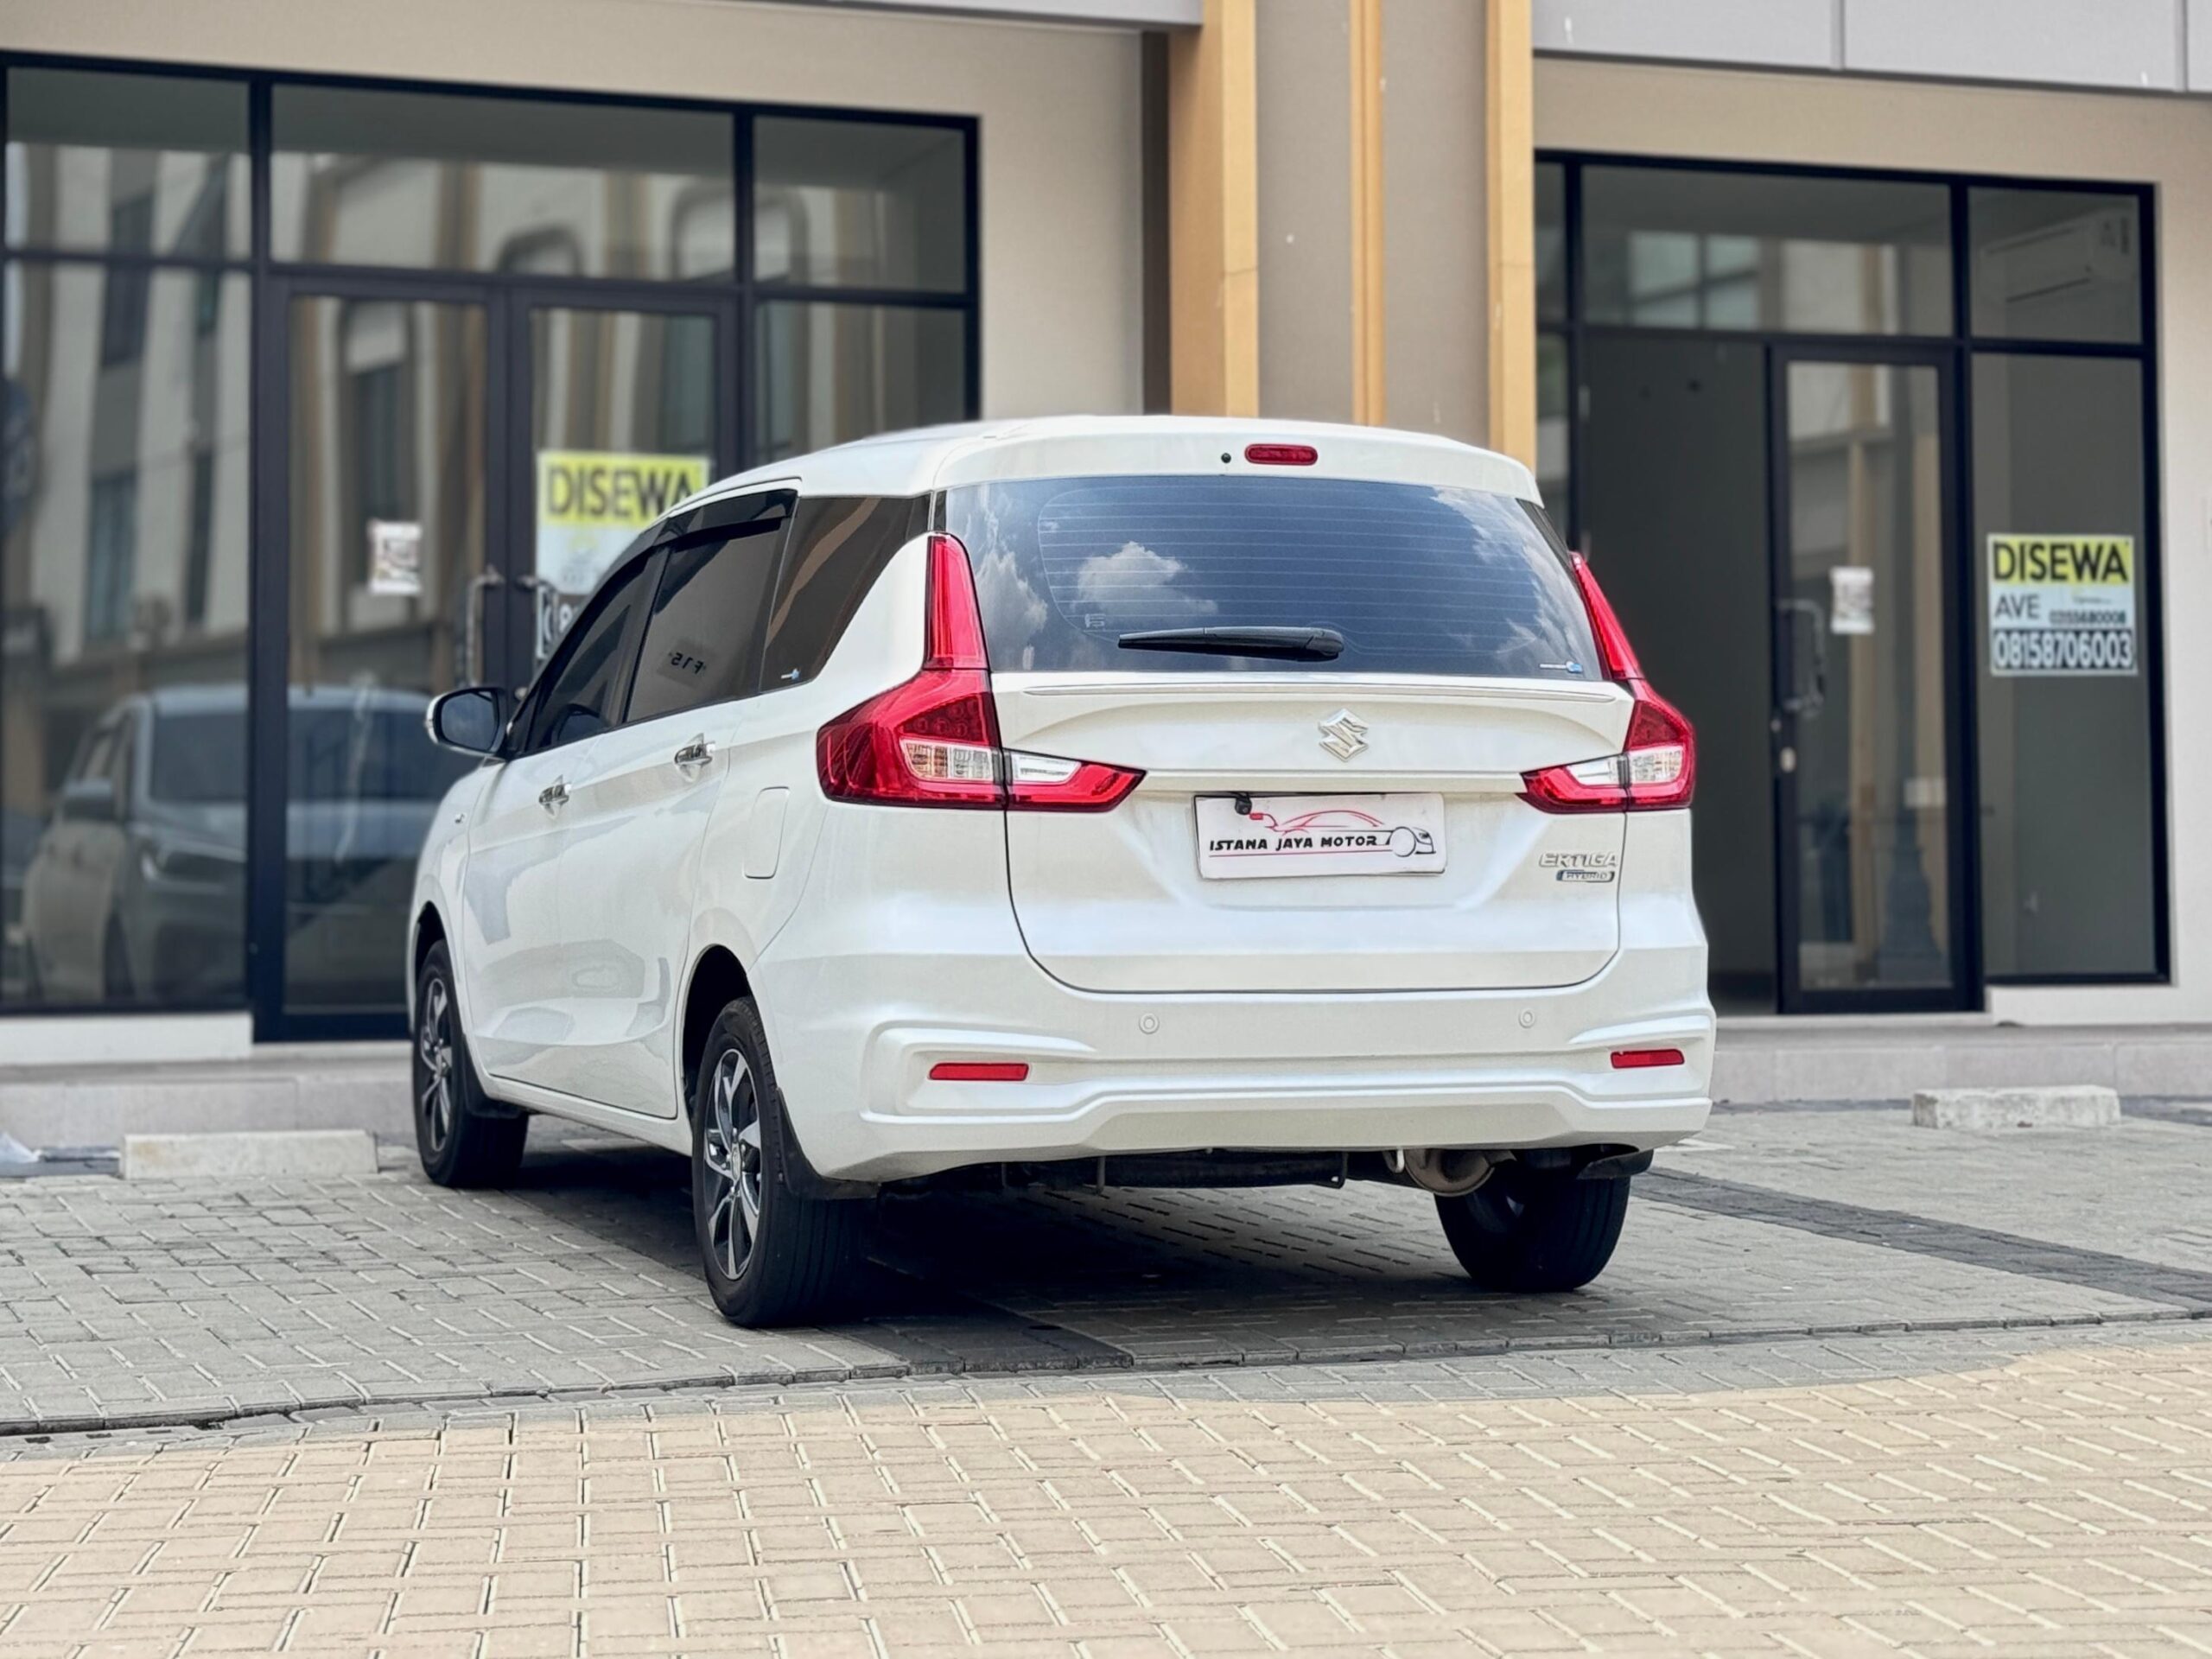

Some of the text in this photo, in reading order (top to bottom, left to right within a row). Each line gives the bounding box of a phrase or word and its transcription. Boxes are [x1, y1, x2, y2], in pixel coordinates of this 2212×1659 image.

[549, 464, 695, 518] DISEWA
[1993, 542, 2129, 582] DISEWA
[1994, 594, 2040, 620] AVE
[1994, 631, 2133, 668] 08158706003
[1210, 836, 1378, 851] ISTANA JAYA MOTOR
[1538, 853, 1618, 868] ERTIGA
